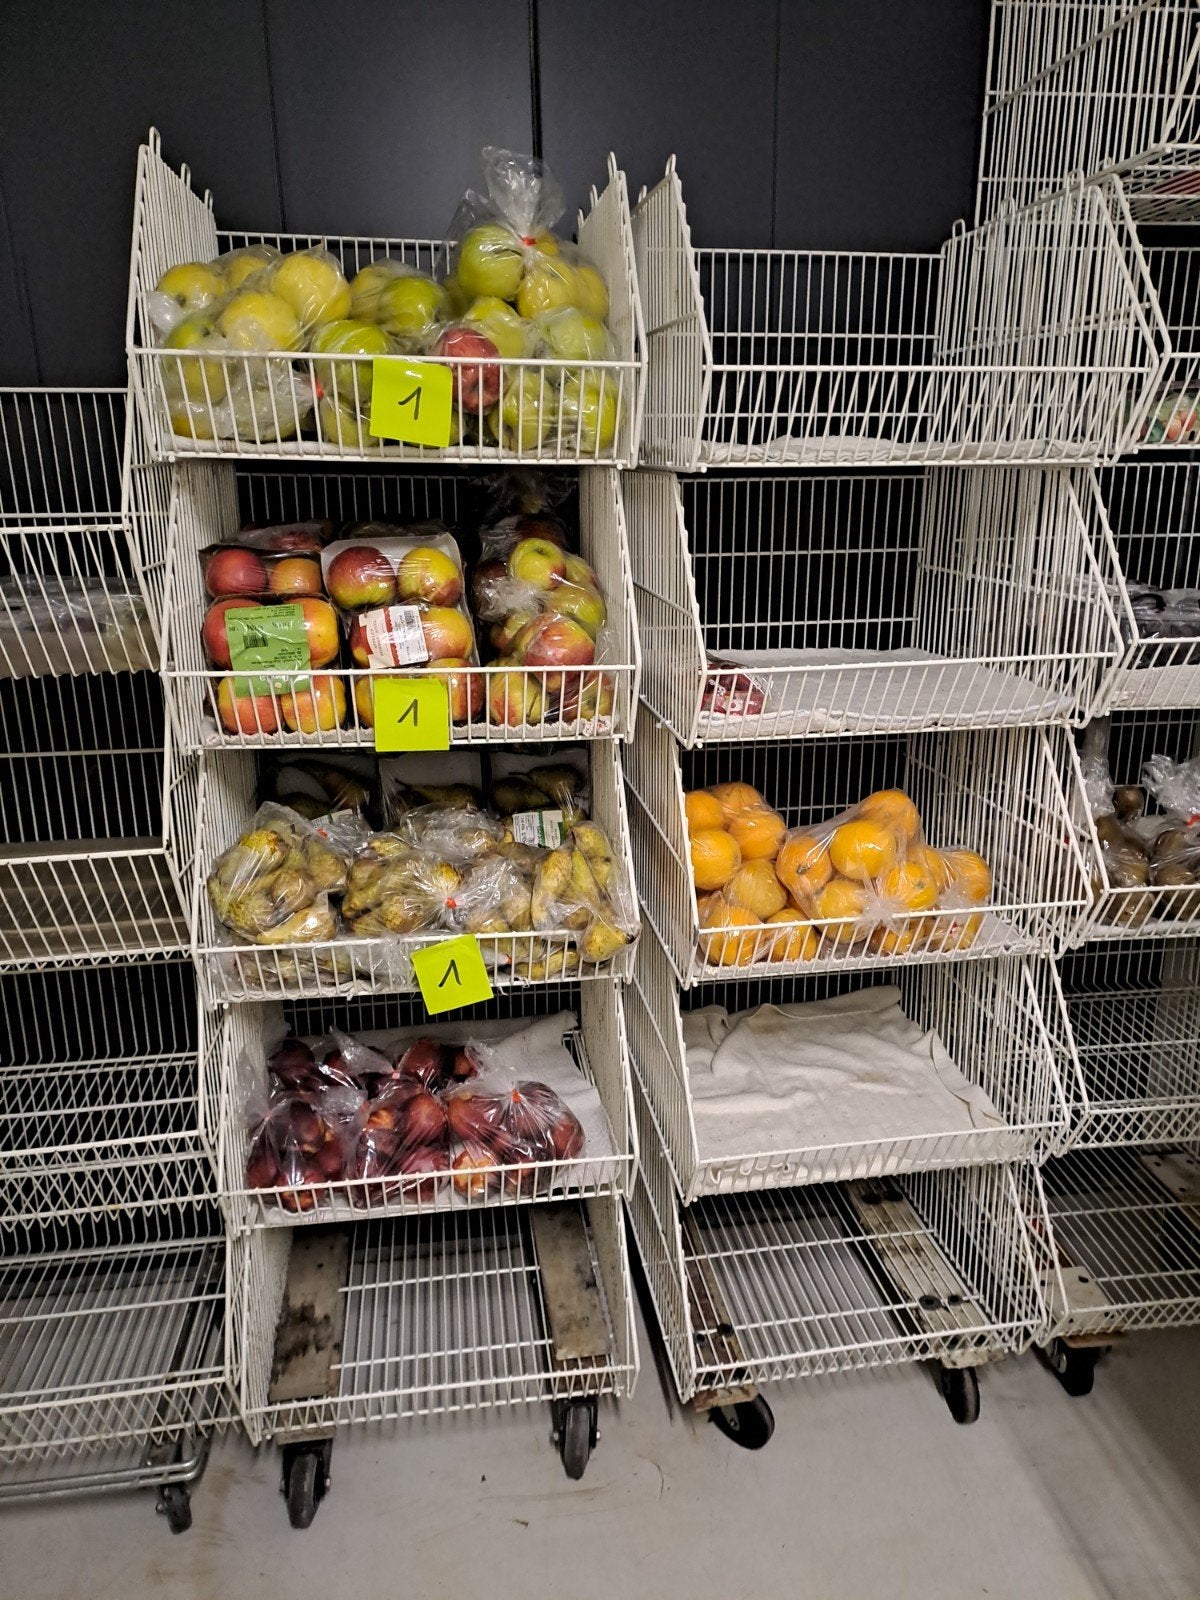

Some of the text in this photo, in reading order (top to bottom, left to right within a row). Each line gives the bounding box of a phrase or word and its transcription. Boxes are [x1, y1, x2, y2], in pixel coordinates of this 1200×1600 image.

[398, 386, 422, 420] 1
[397, 698, 418, 727] 1
[438, 959, 462, 988] 1
